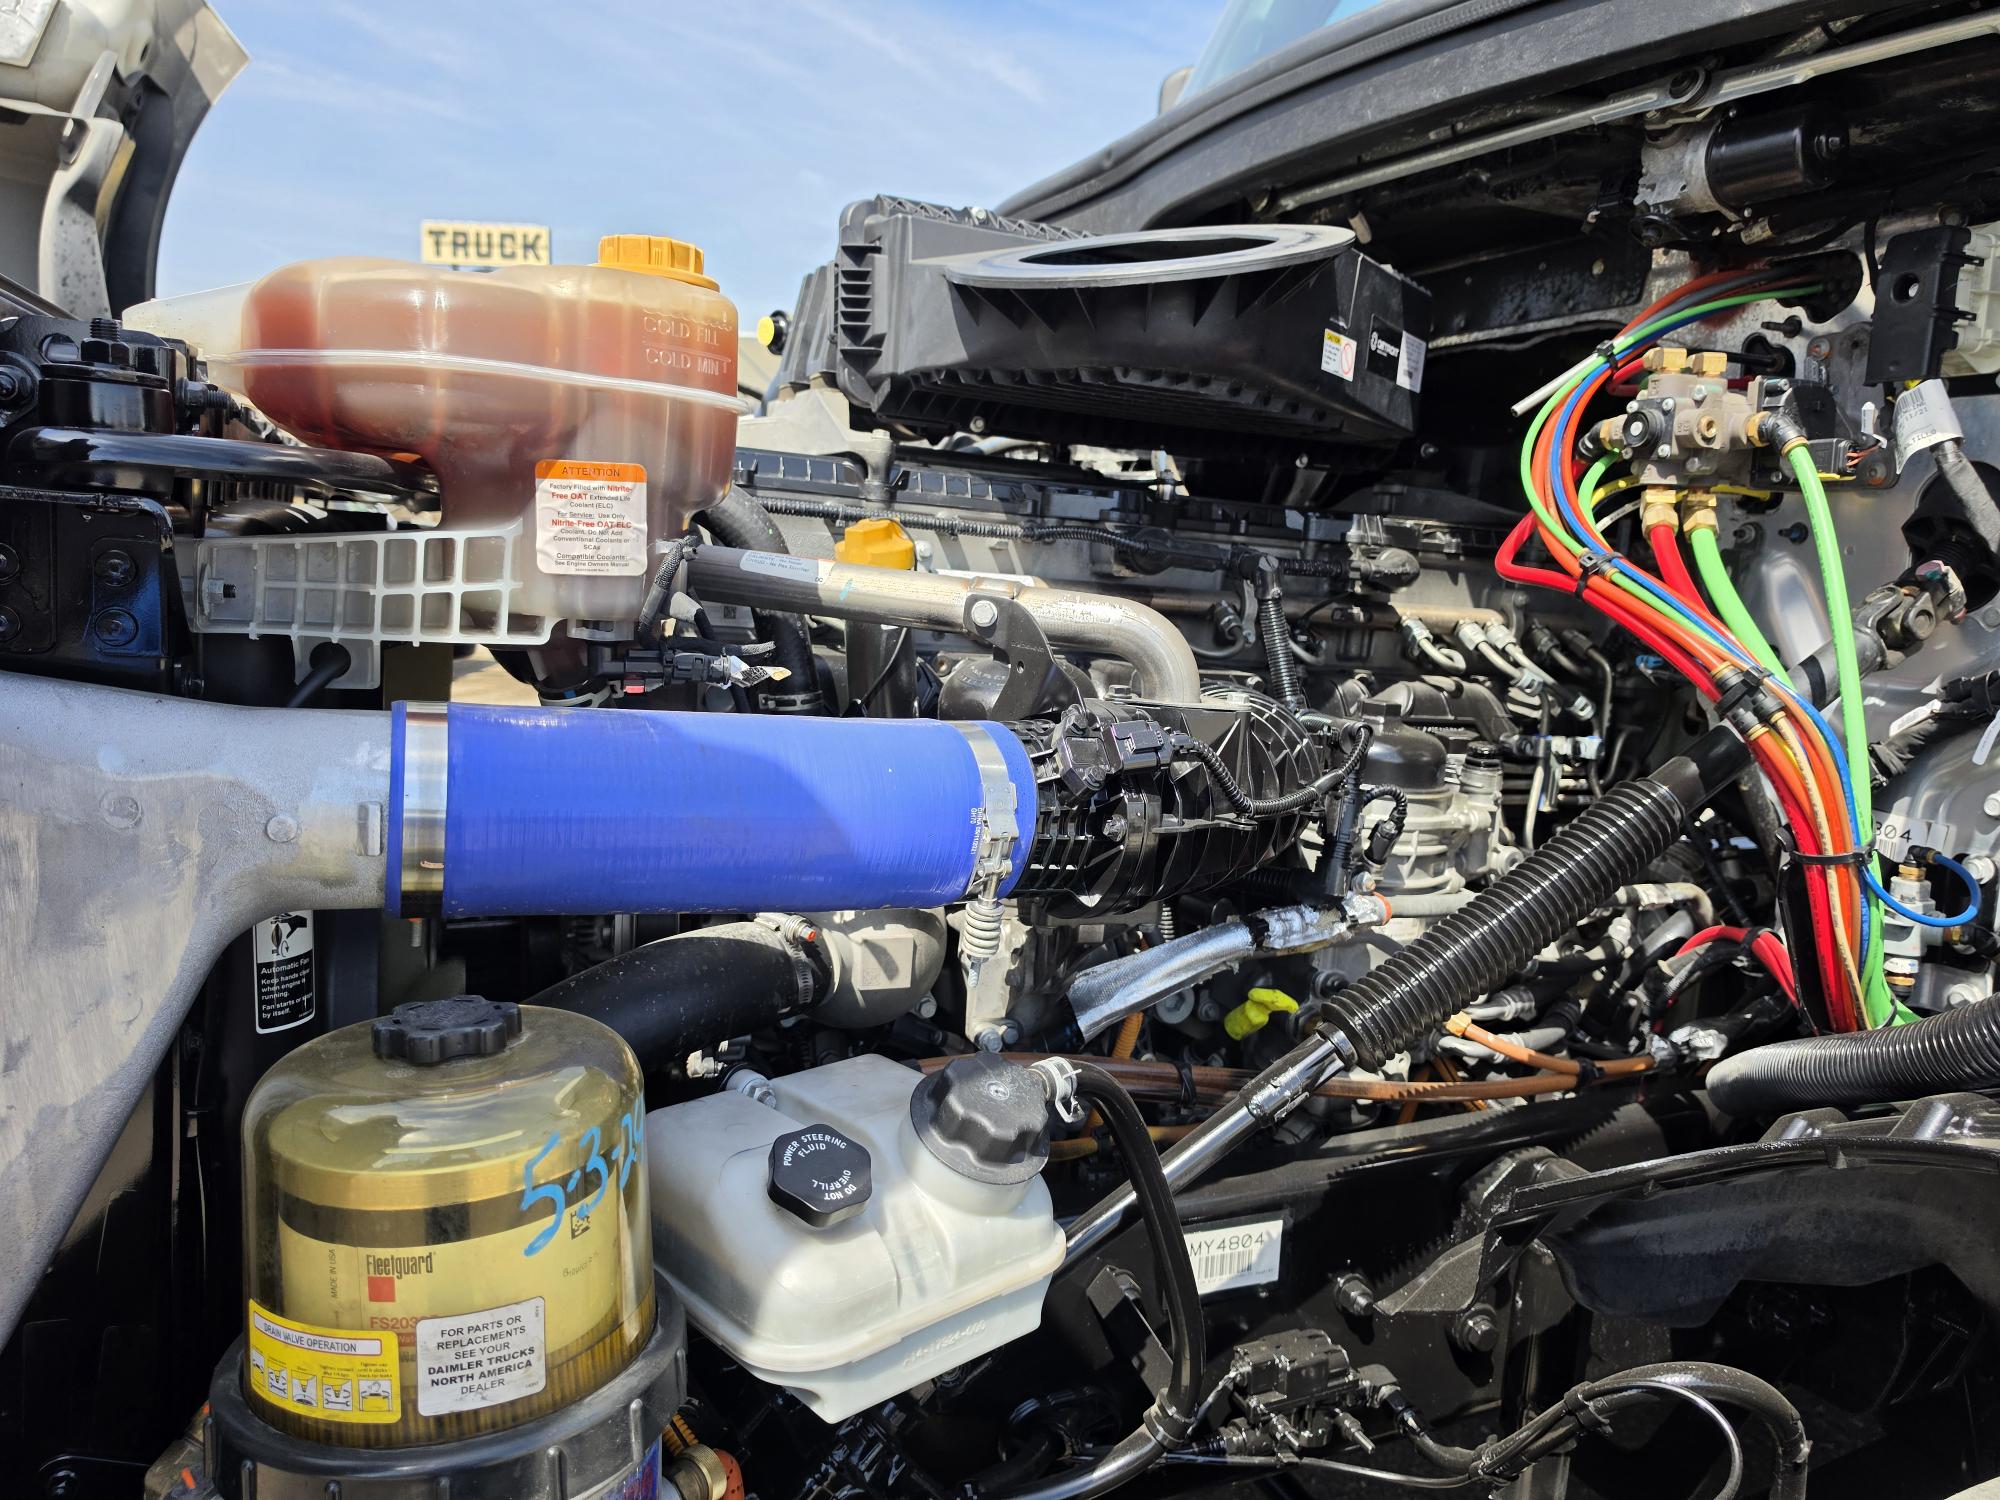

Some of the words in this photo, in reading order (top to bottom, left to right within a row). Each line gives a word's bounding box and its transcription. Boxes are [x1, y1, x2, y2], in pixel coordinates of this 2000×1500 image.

[428, 230, 542, 261] TRUCK
[643, 316, 691, 338] COLD
[696, 325, 719, 346] FILL
[646, 347, 691, 369] COLD
[697, 356, 719, 376] MIN
[562, 466, 620, 477] ATTENTION
[549, 483, 572, 491] Factory
[607, 485, 633, 493] Nitrite-
[551, 492, 569, 500] Free
[570, 493, 589, 501] OAT
[551, 519, 596, 528] Nitrite-Free
[616, 521, 632, 529] ELC
[553, 535, 594, 543] Conventional
[556, 552, 594, 560] Compatible
[261, 961, 299, 975] Automatic
[299, 957, 310, 967] Fan
[261, 977, 280, 986] Keep
[280, 972, 299, 982] hands
[261, 984, 281, 993] when
[281, 979, 301, 990] engine
[261, 991, 290, 1001] running.
[262, 1003, 275, 1011] Fan
[276, 999, 295, 1009] starts
[272, 1007, 291, 1017] itself.
[783, 1140, 800, 1167] POWER
[801, 1133, 847, 1149] STEERING
[798, 1143, 826, 1158] FLUID
[811, 1169, 852, 1191] OVERFILL
[823, 1190, 844, 1201] NOT
[844, 1183, 857, 1195] DO
[328, 1248, 336, 1265] USA
[329, 1265, 336, 1275] IN
[366, 1251, 433, 1280] Fleetguard
[330, 1275, 338, 1300] MADE
[441, 1327, 464, 1338] FOR
[467, 1319, 503, 1335] PARTS
[506, 1315, 522, 1326] OR
[263, 1322, 282, 1340] DRAIN
[283, 1331, 305, 1346] VALVE
[306, 1337, 358, 1353] OPERATION
[436, 1325, 527, 1351] REPLACEMENTS
[454, 1348, 477, 1361] SEE
[479, 1341, 511, 1357] YOUR
[427, 1359, 483, 1376] DAIMLER
[486, 1346, 536, 1366] TRUCKS
[430, 1373, 475, 1388] NORTH
[478, 1359, 533, 1381] AMERICA
[460, 1378, 506, 1396] DEALER
